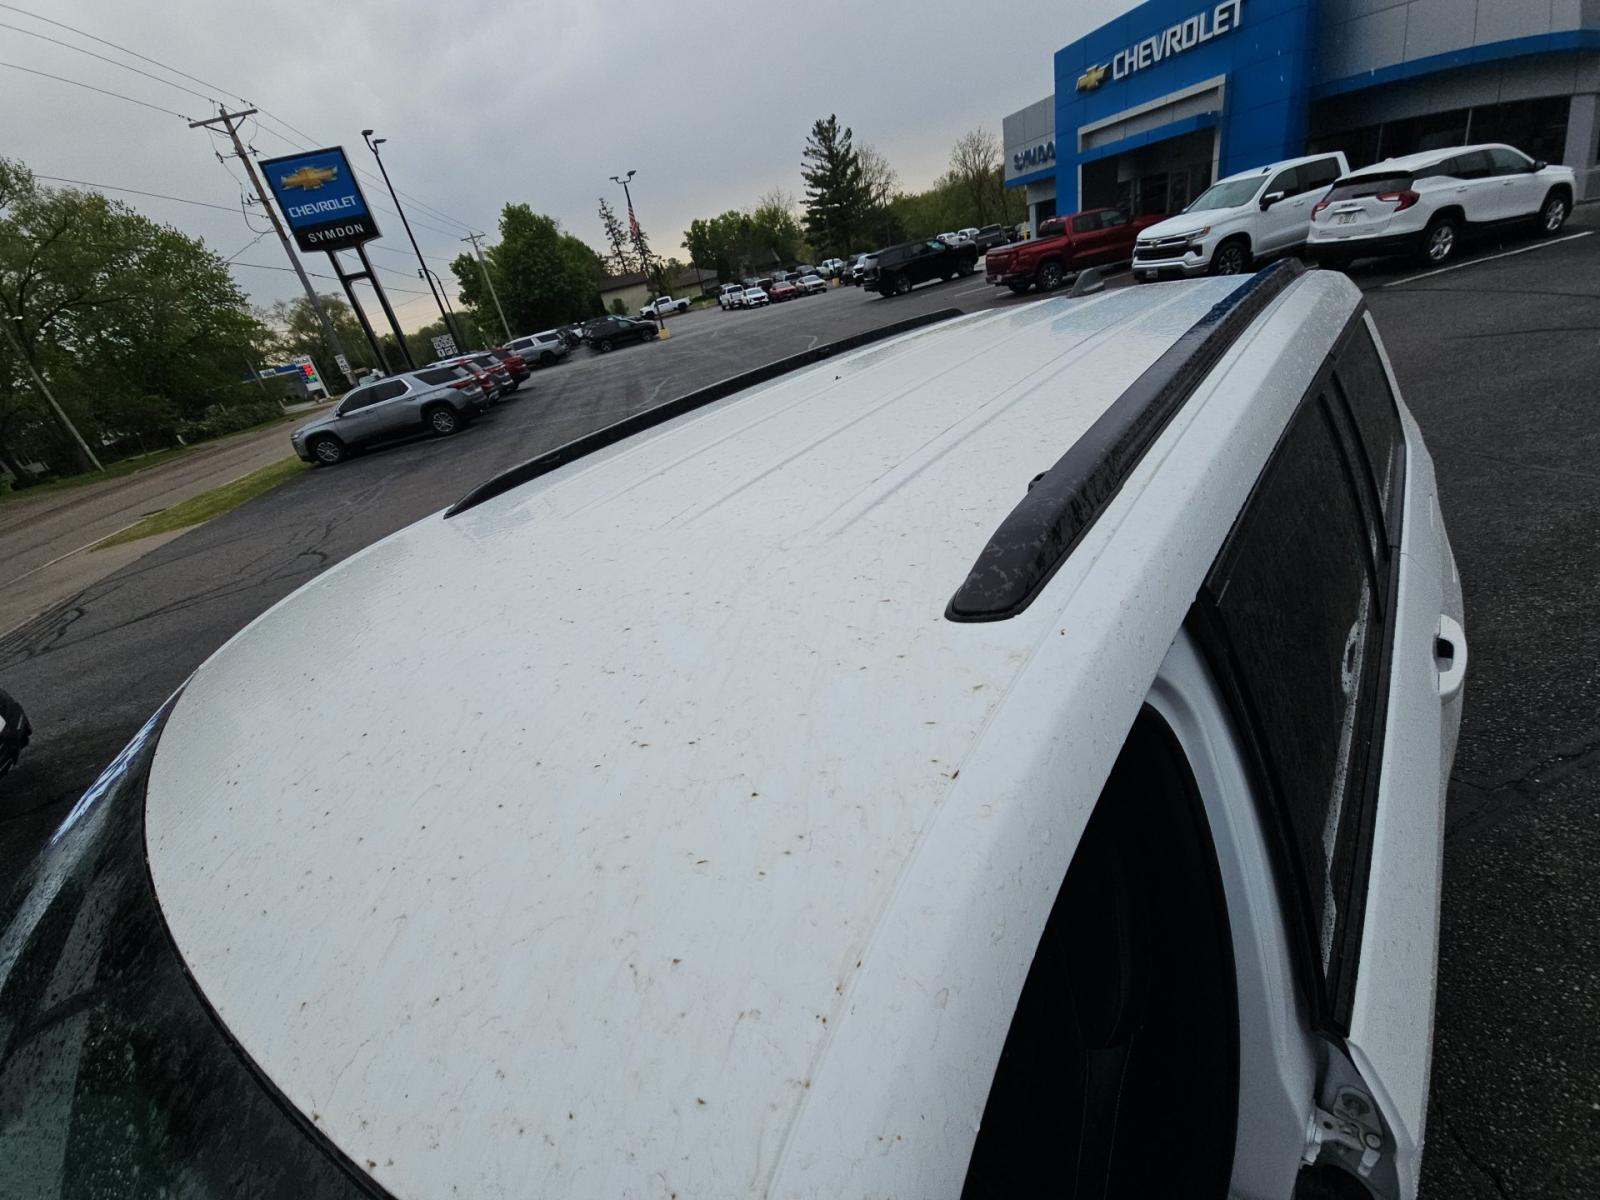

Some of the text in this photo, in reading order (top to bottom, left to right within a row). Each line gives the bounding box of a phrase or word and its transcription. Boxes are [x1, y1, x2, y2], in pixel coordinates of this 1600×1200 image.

[1112, 0, 1242, 81] CHEVROLET
[288, 195, 357, 218] CHEVROLET
[308, 223, 364, 243] SYMDON
